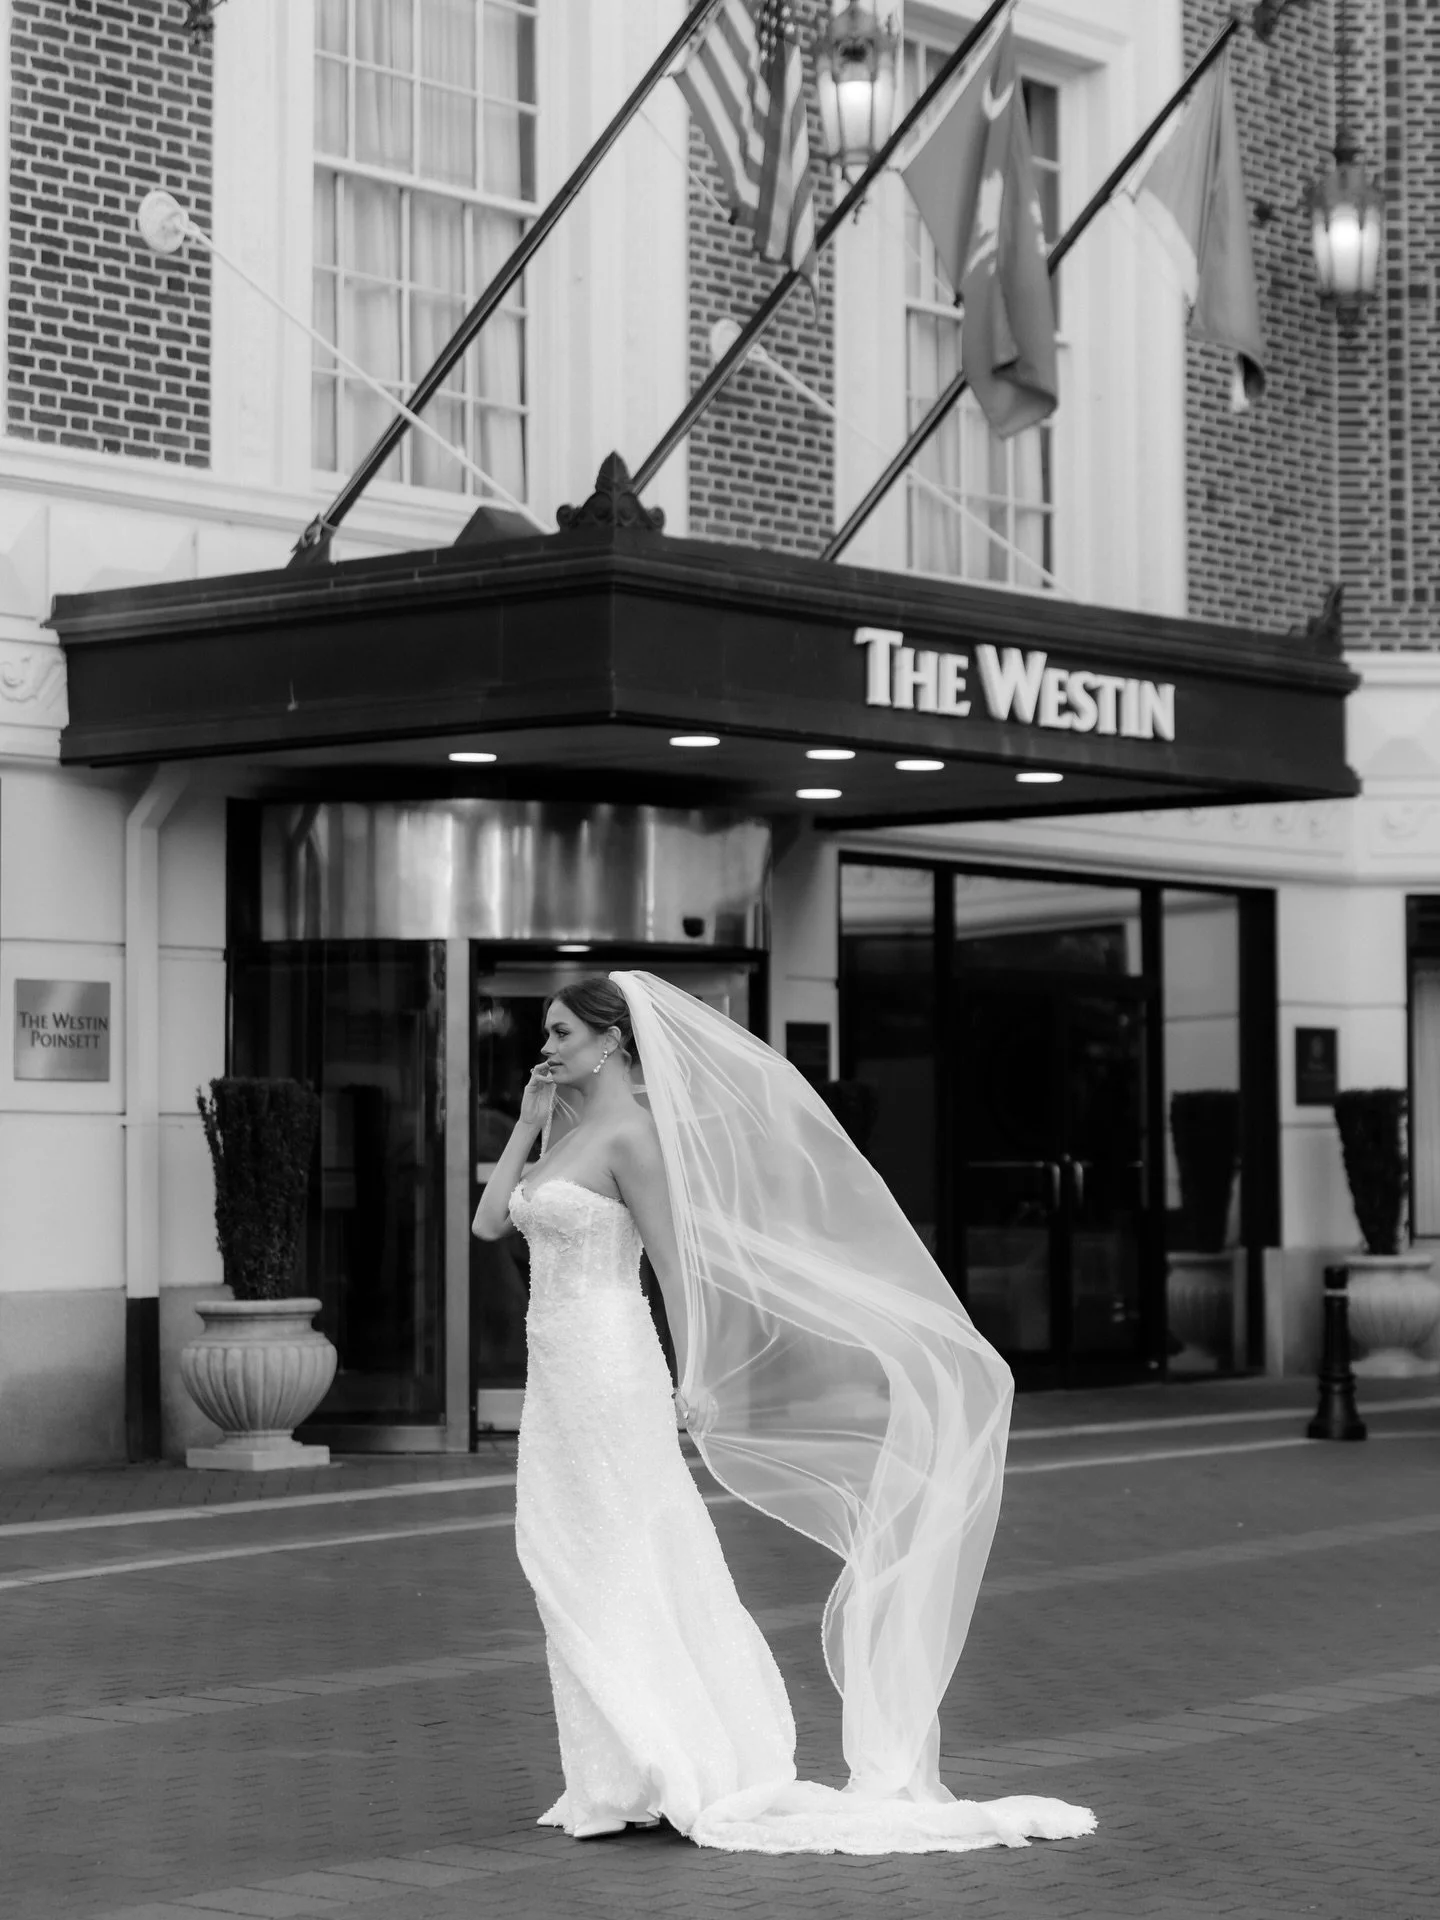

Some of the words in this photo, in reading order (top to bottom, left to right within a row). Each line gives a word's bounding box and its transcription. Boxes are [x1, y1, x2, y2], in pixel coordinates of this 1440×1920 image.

[853, 627, 972, 717] THE
[975, 643, 1176, 742] WESTIN
[18, 1011, 48, 1029] THE
[52, 1012, 109, 1031] WESTIN
[31, 1030, 100, 1049] POINSETT
